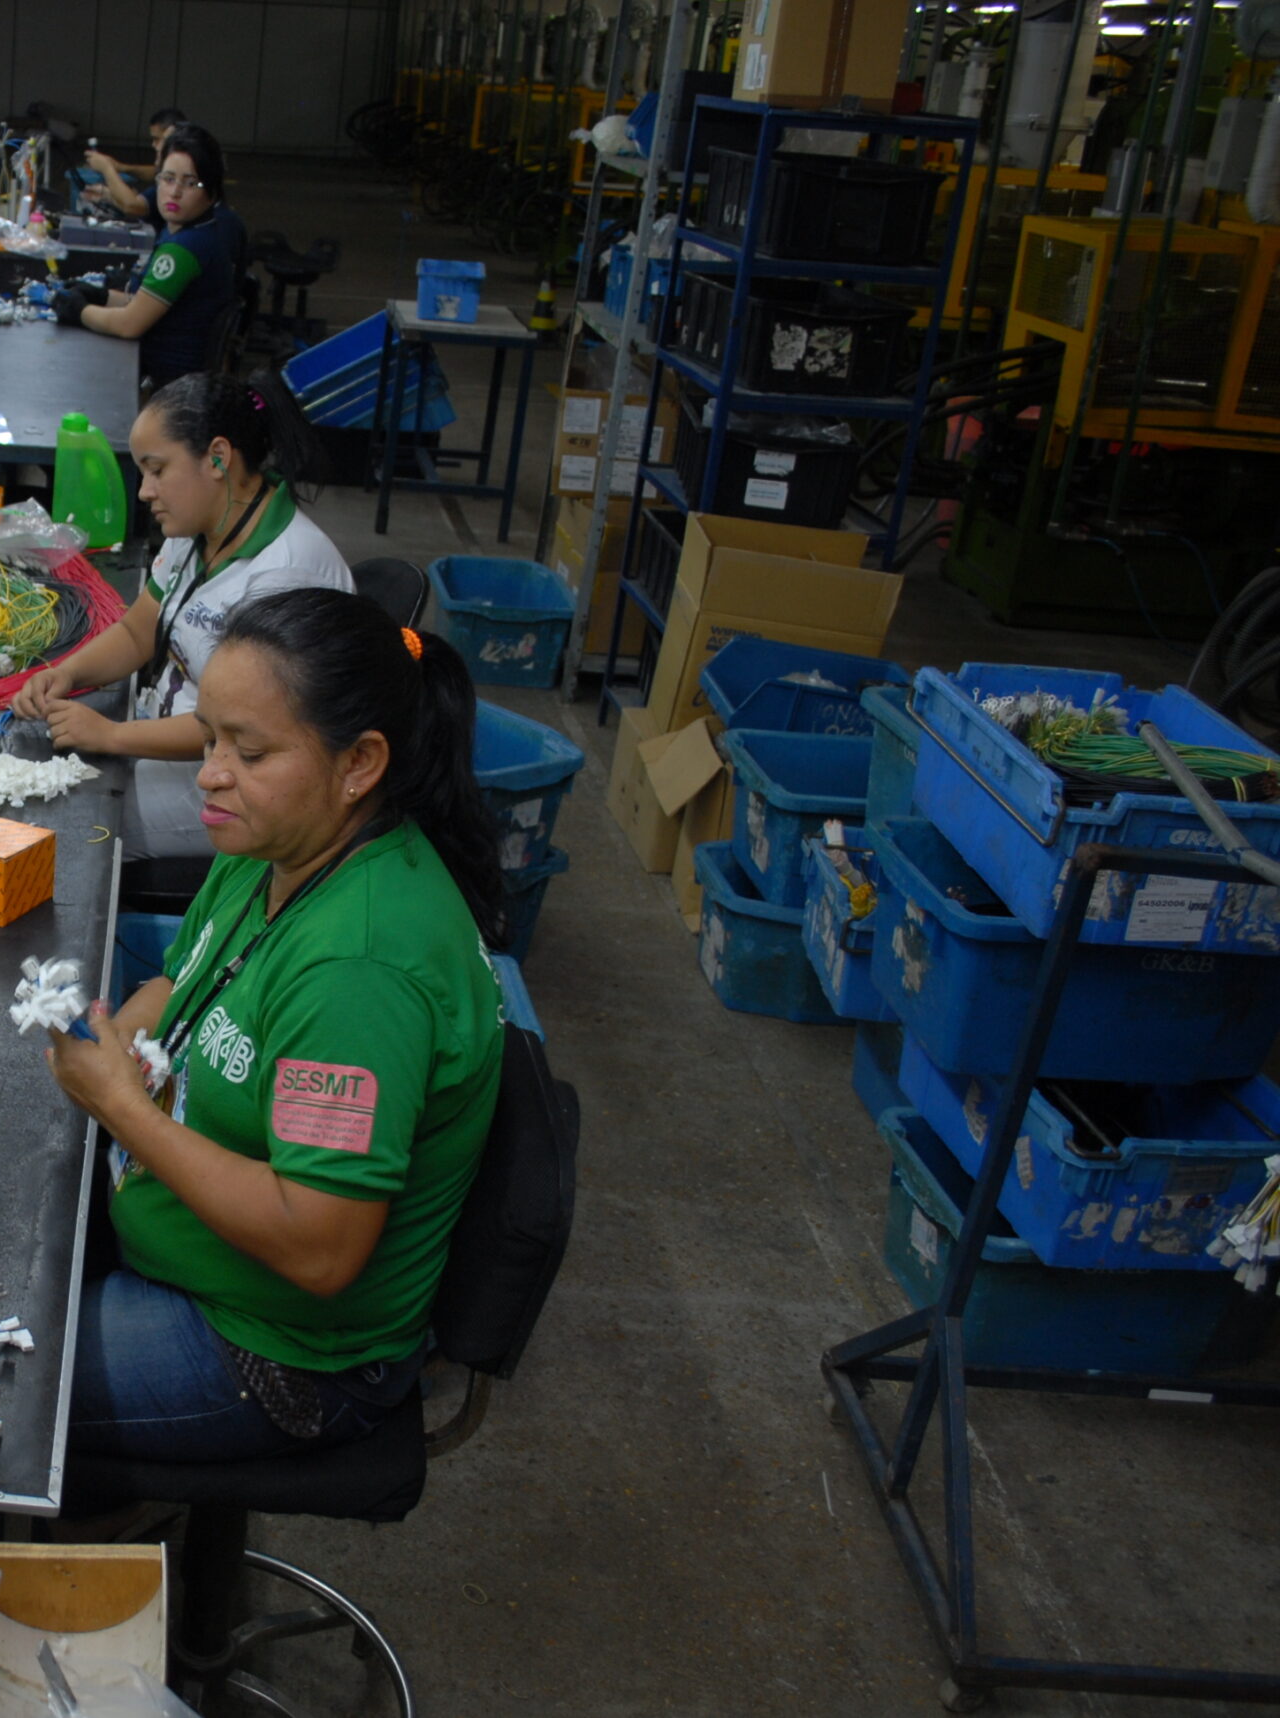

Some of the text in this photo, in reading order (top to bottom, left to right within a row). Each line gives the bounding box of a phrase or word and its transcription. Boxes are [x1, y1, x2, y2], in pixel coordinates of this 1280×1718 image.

[1141, 952, 1216, 972] GK&B
[198, 1006, 256, 1084] GK&B
[282, 1068, 366, 1098] SESMT
